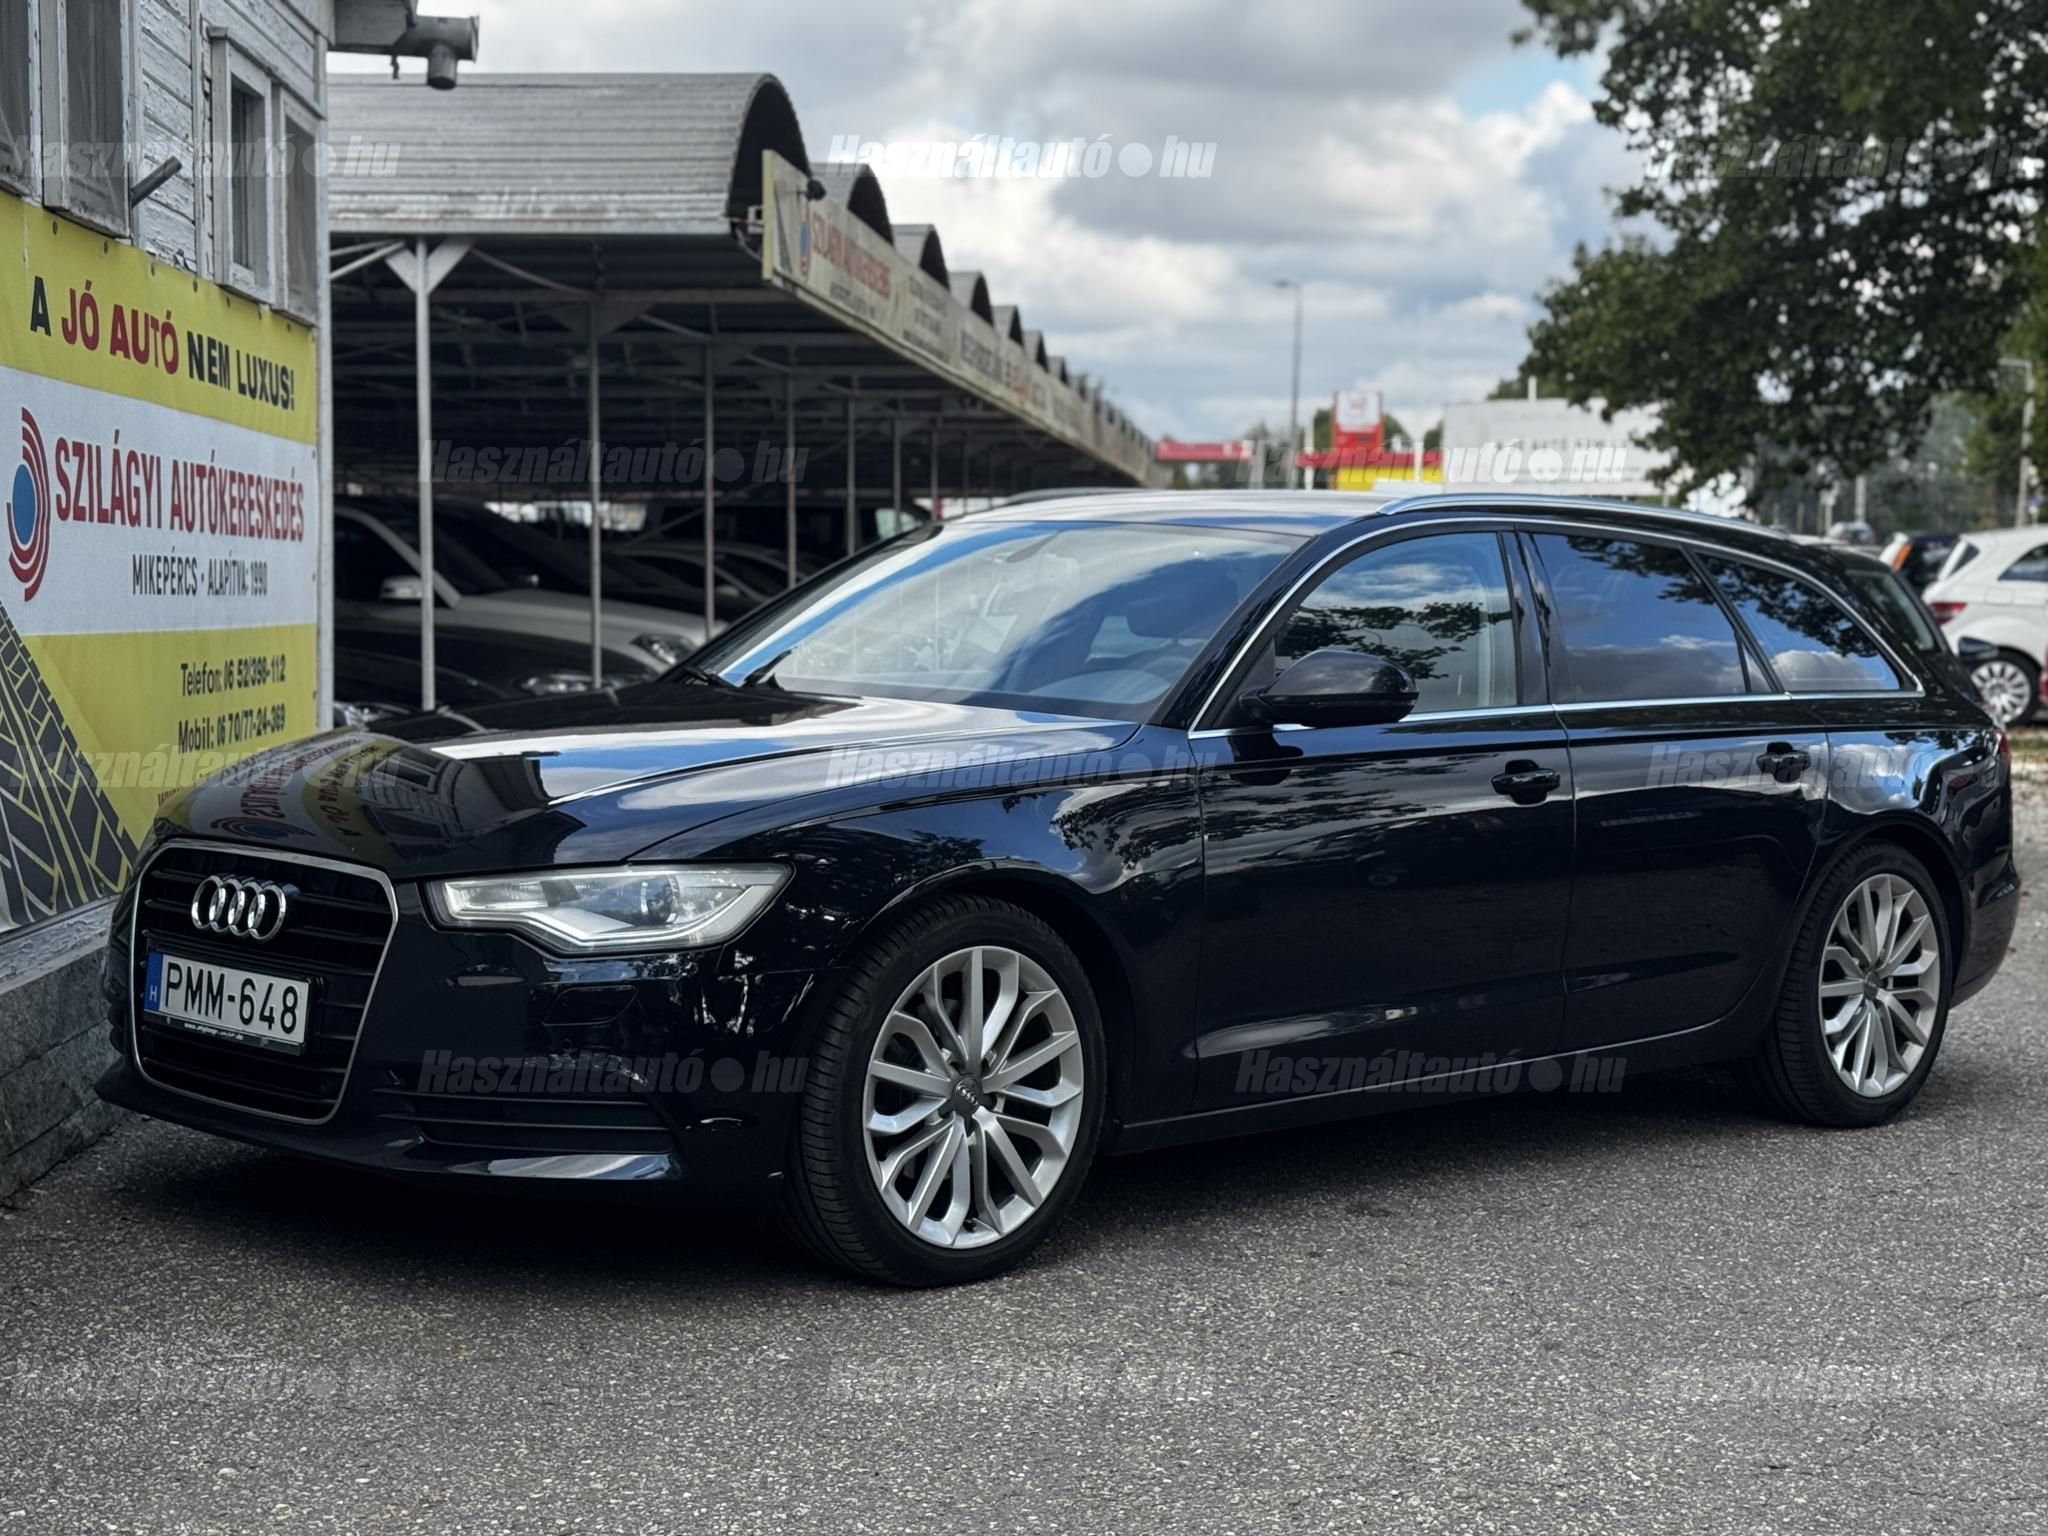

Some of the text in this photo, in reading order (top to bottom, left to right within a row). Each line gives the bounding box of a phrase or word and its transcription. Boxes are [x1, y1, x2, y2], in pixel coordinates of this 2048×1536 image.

[30, 275, 295, 411] A JÓ AUTÓ NEM LUXUS!
[55, 429, 304, 542] SZILÁGYI AUTÓKERESKEDÉS
[132, 545, 198, 596] MIKEPÉRCS
[178, 717, 214, 754] Mobil:
[165, 961, 299, 1034] PMM-648
